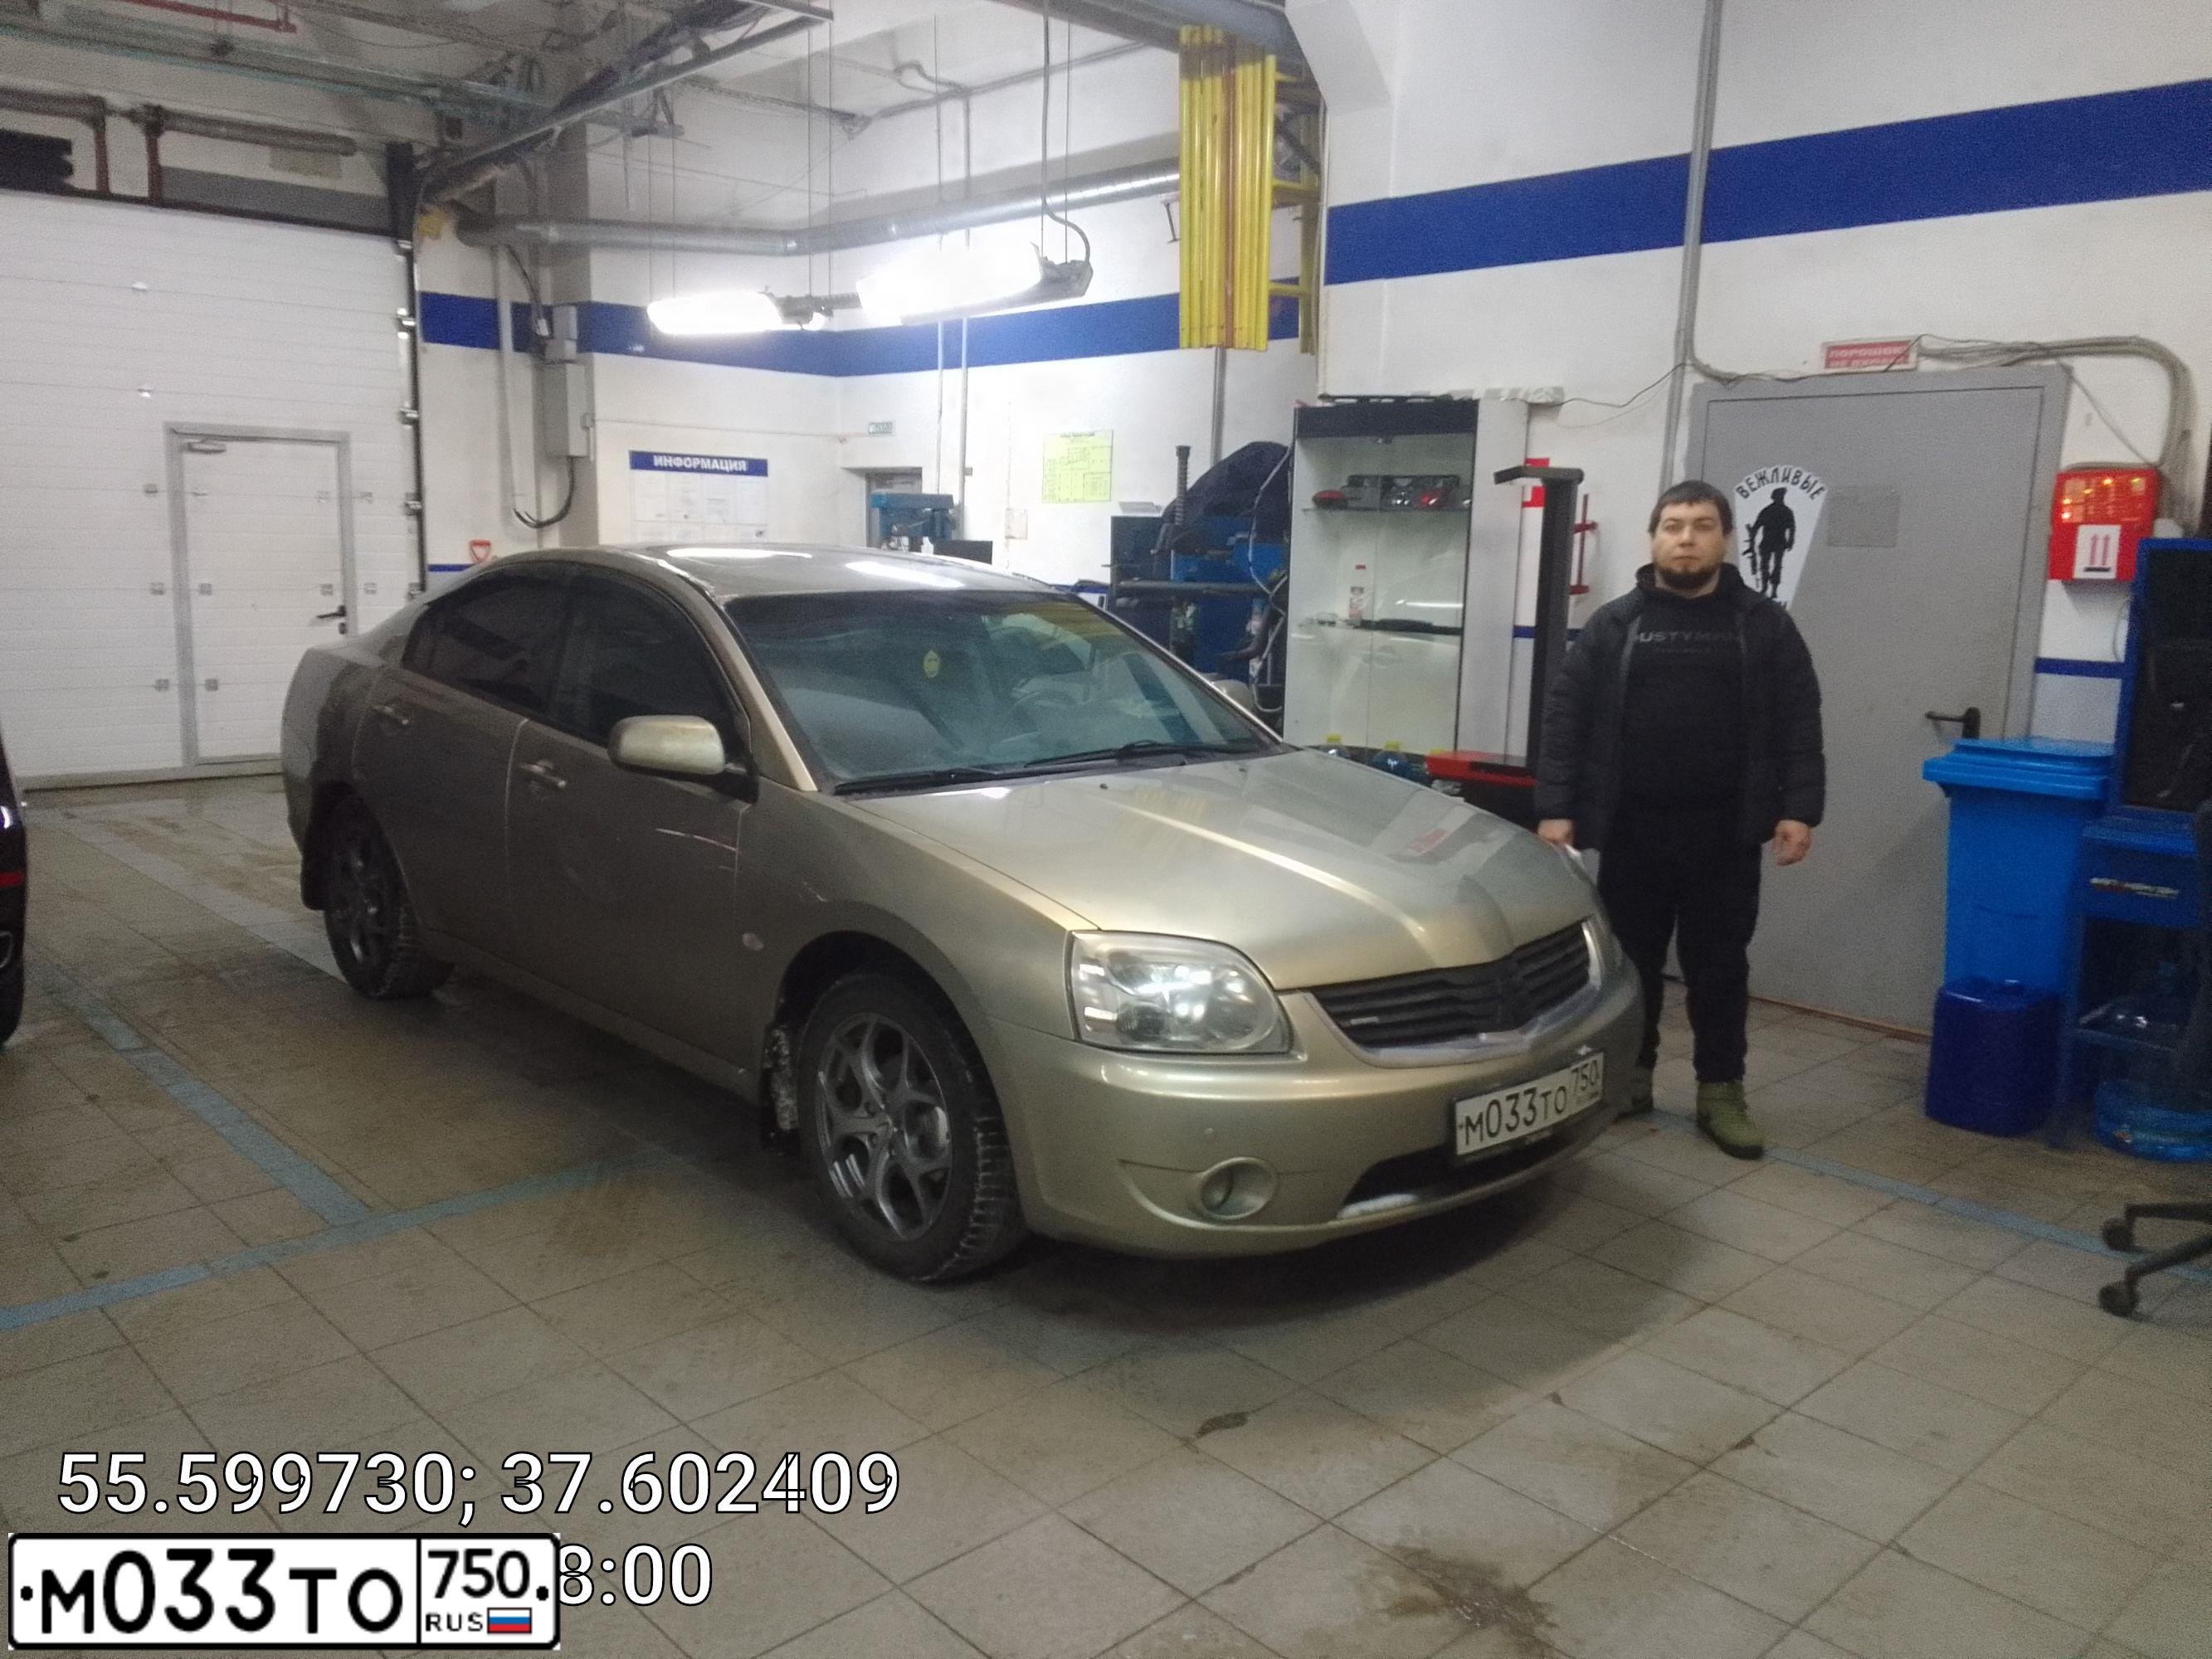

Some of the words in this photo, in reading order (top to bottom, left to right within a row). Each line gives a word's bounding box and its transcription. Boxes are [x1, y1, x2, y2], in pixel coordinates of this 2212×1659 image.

[653, 455, 747, 472] ИНФОРМАЦИЯ
[1736, 466, 1825, 499] ВЕЖЛИВЫЕ
[1464, 1085, 1567, 1146] М033ТО
